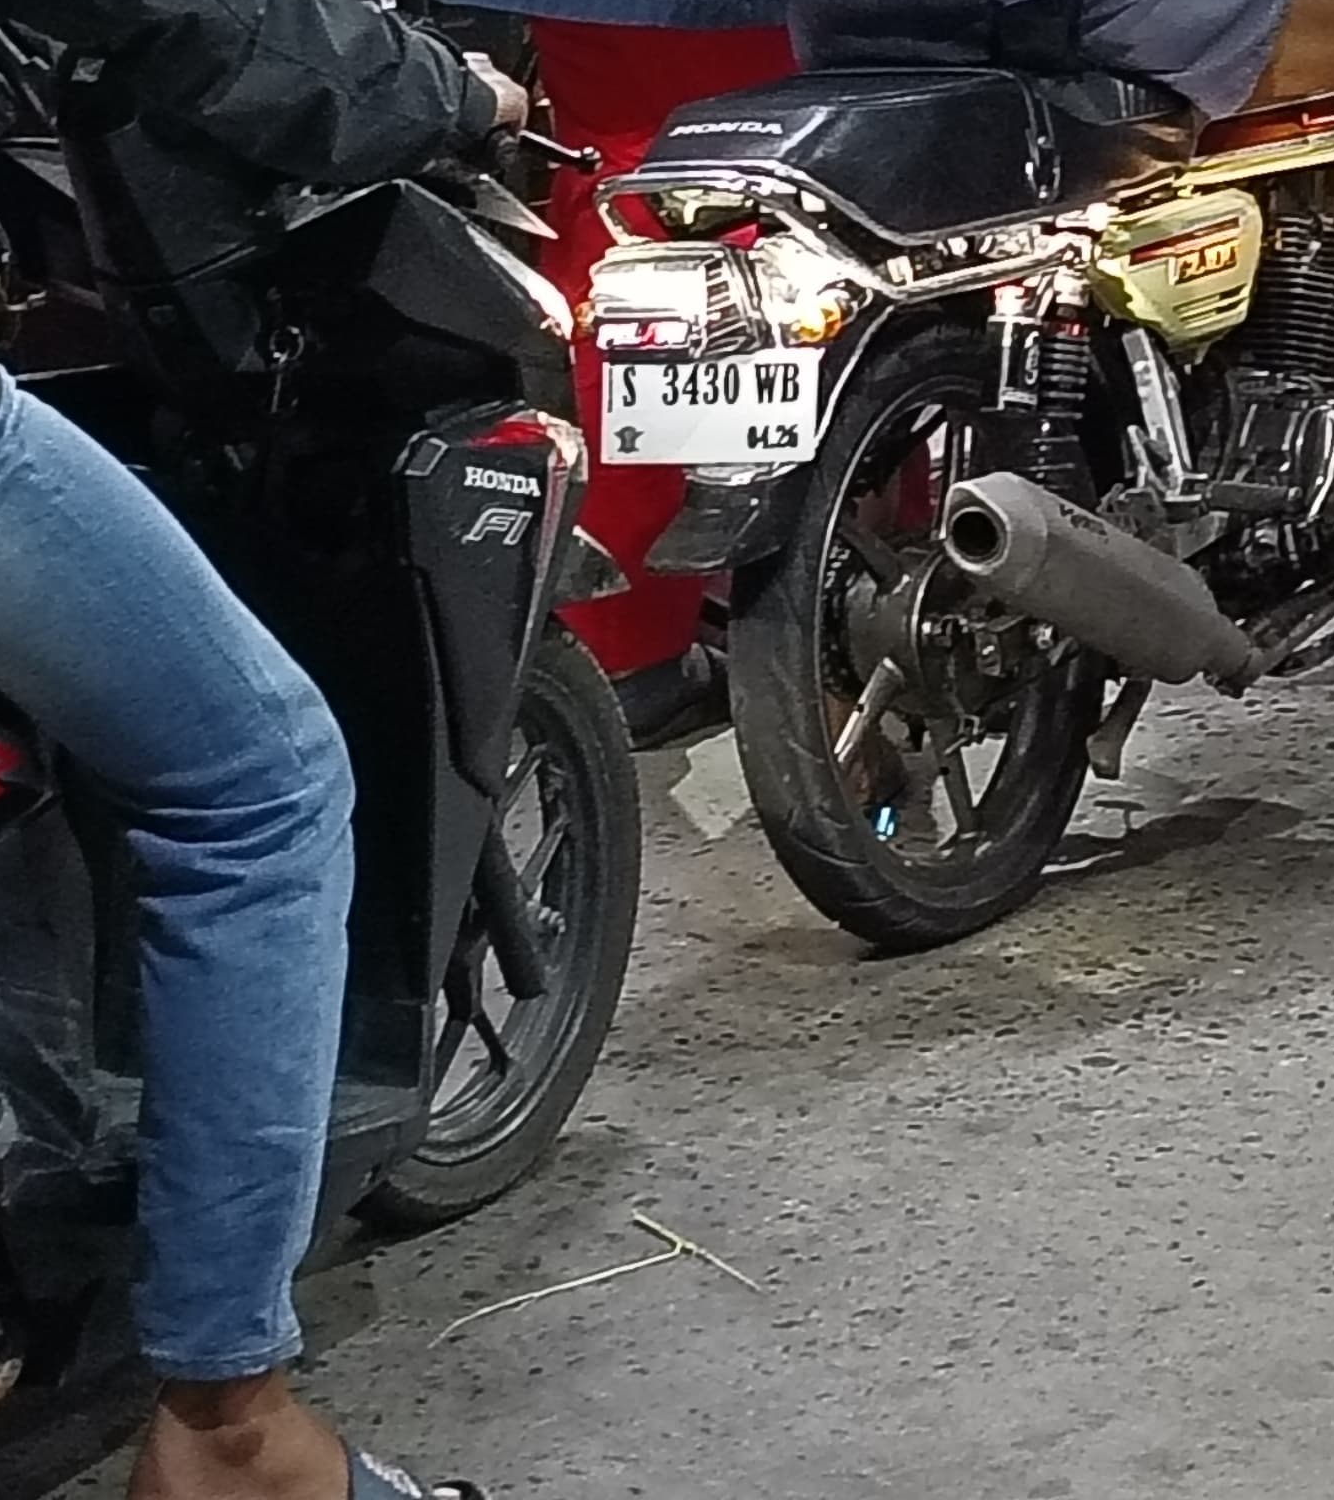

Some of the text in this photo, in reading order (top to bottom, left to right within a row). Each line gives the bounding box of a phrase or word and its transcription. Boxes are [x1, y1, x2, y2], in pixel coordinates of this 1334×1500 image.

[668, 121, 783, 137] HONDA
[622, 363, 800, 407] S 3430 WB
[463, 466, 541, 497] HONDA
